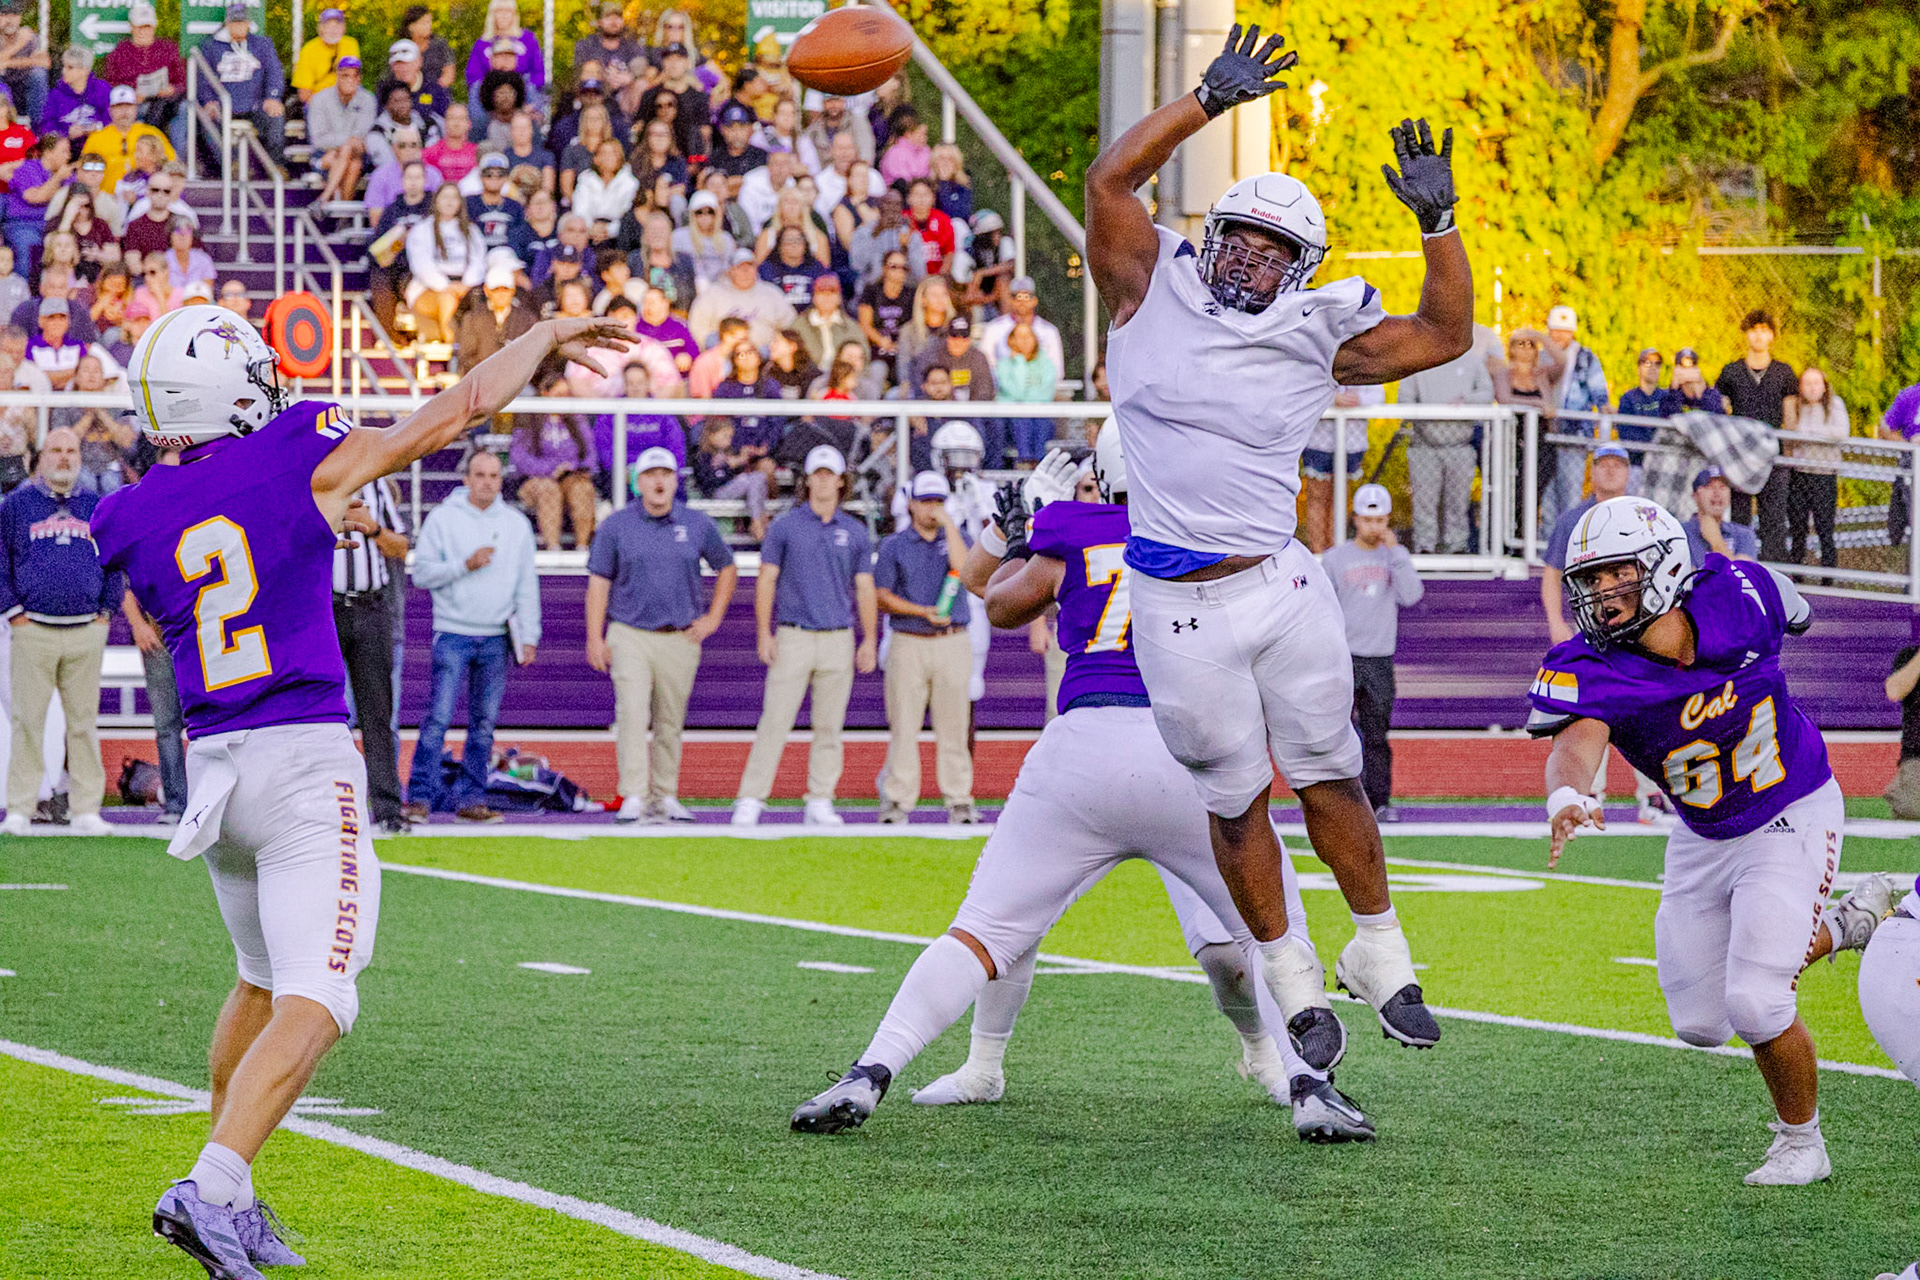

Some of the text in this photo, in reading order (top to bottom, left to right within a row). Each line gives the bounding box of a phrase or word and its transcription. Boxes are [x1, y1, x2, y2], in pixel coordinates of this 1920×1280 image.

[751, 1, 826, 18] VISITOR
[1250, 207, 1282, 223] Riddell
[146, 434, 194, 447] ddell
[174, 514, 273, 693] 2
[1680, 680, 1738, 730] Cal
[1662, 695, 1786, 809] 64
[327, 780, 359, 976] FIGHTING SCOTS
[1818, 830, 1837, 898] SCOTS
